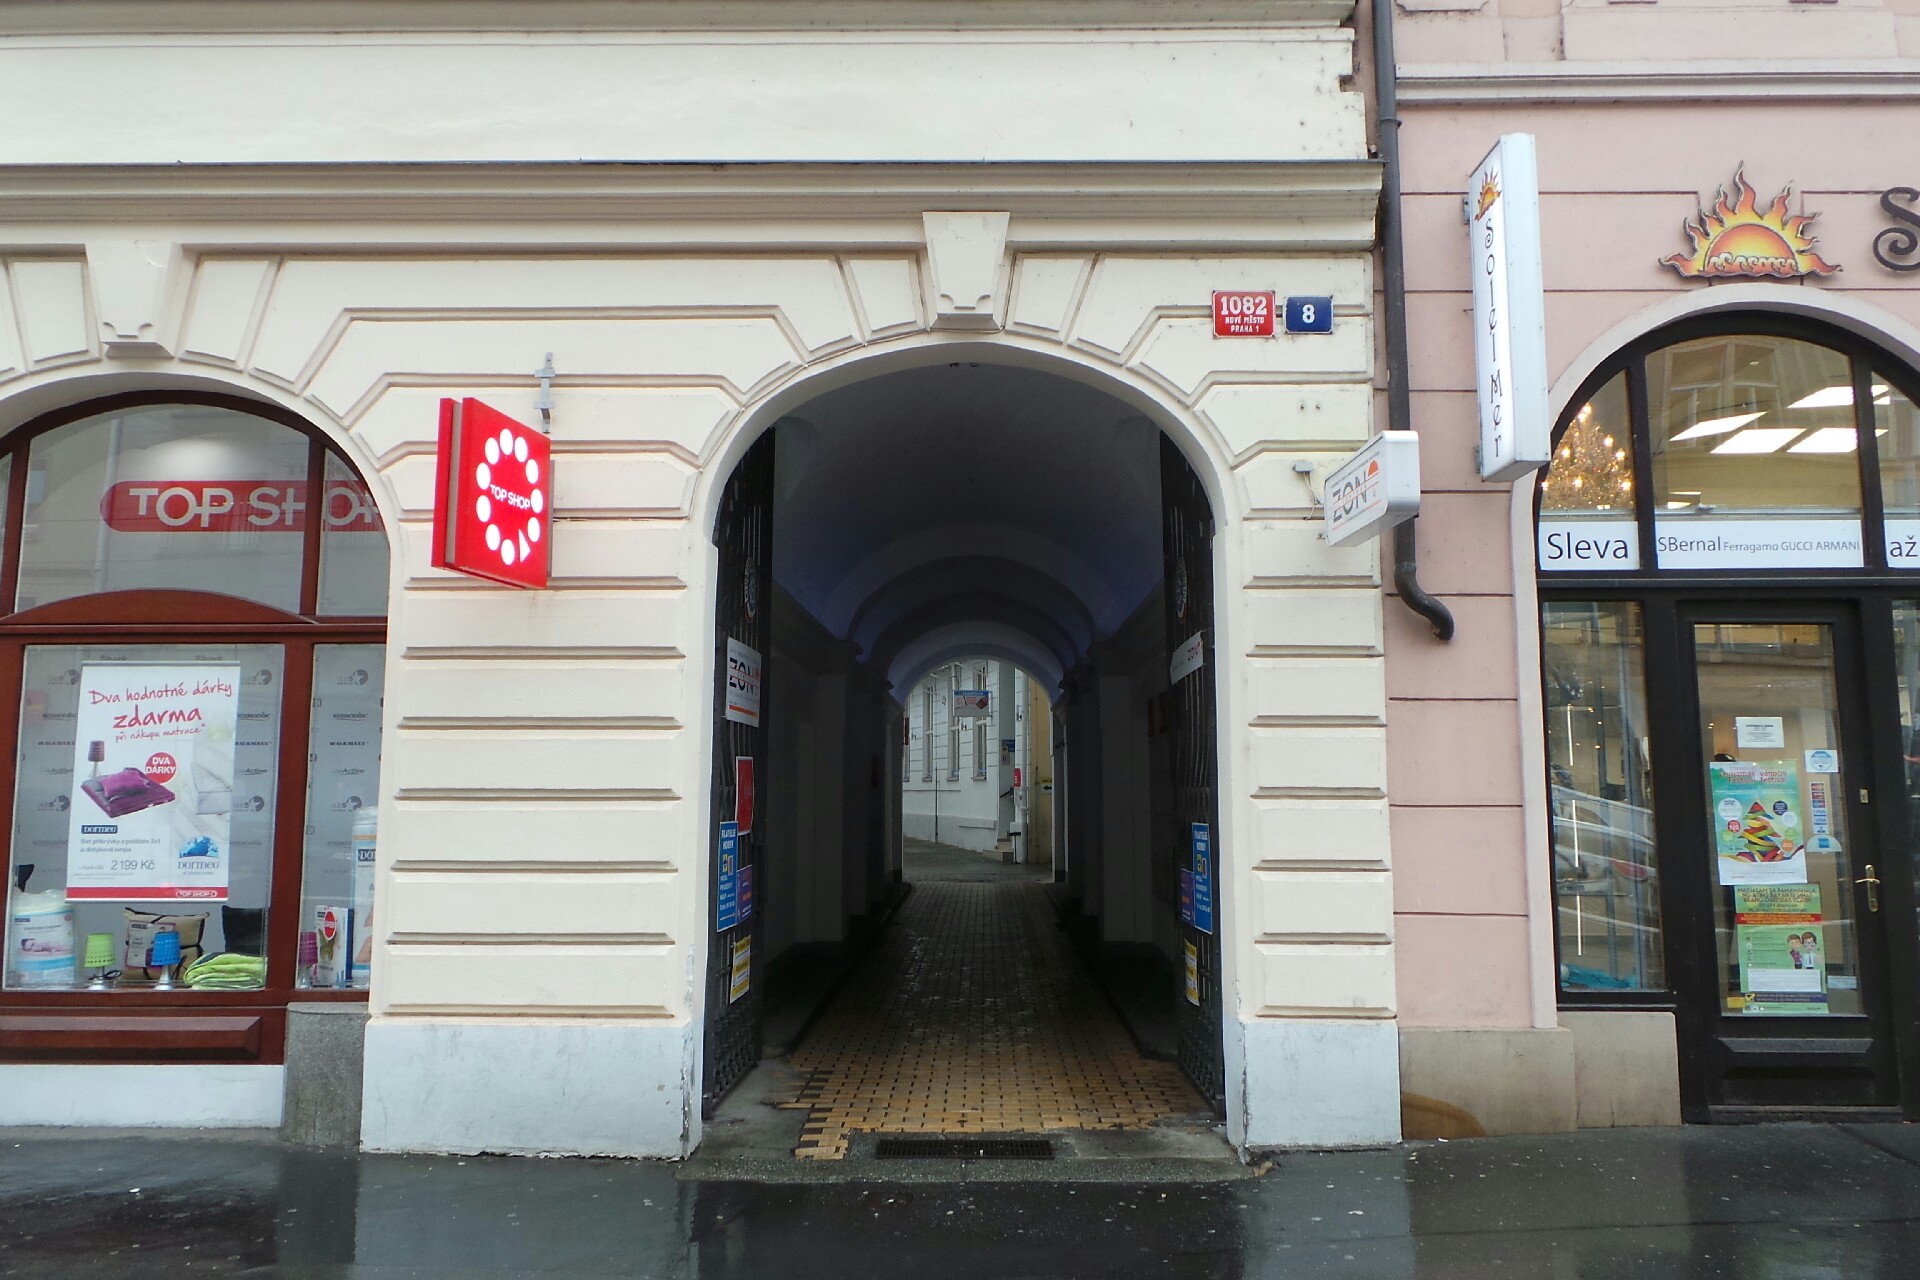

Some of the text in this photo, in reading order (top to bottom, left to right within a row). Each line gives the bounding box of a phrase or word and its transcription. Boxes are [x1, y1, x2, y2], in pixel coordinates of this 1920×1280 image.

[1220, 296, 1267, 315] 1082
[1225, 315, 1265, 324] NOVÉ MĚSTO
[1302, 304, 1315, 324] 8
[1230, 325, 1260, 333] PRAHA 1
[489, 484, 531, 510] TOP SHOP
[129, 487, 234, 528] TOP
[1546, 532, 1629, 560] Sleva
[1723, 541, 1779, 553] Ferragamo
[1781, 541, 1813, 551] GUCCI
[1816, 541, 1860, 551] ARMANI
[1889, 535, 1919, 558] až
[88, 689, 121, 705] Dva
[126, 682, 187, 702] hodnotné
[192, 678, 234, 698] dárky
[113, 704, 202, 729] zdarma
[115, 731, 127, 743] při
[130, 729, 160, 741] nákupu
[152, 757, 171, 765] DVA
[145, 765, 177, 774] DÁRKY
[360, 850, 376, 860] DO
[141, 859, 155, 871] Kč
